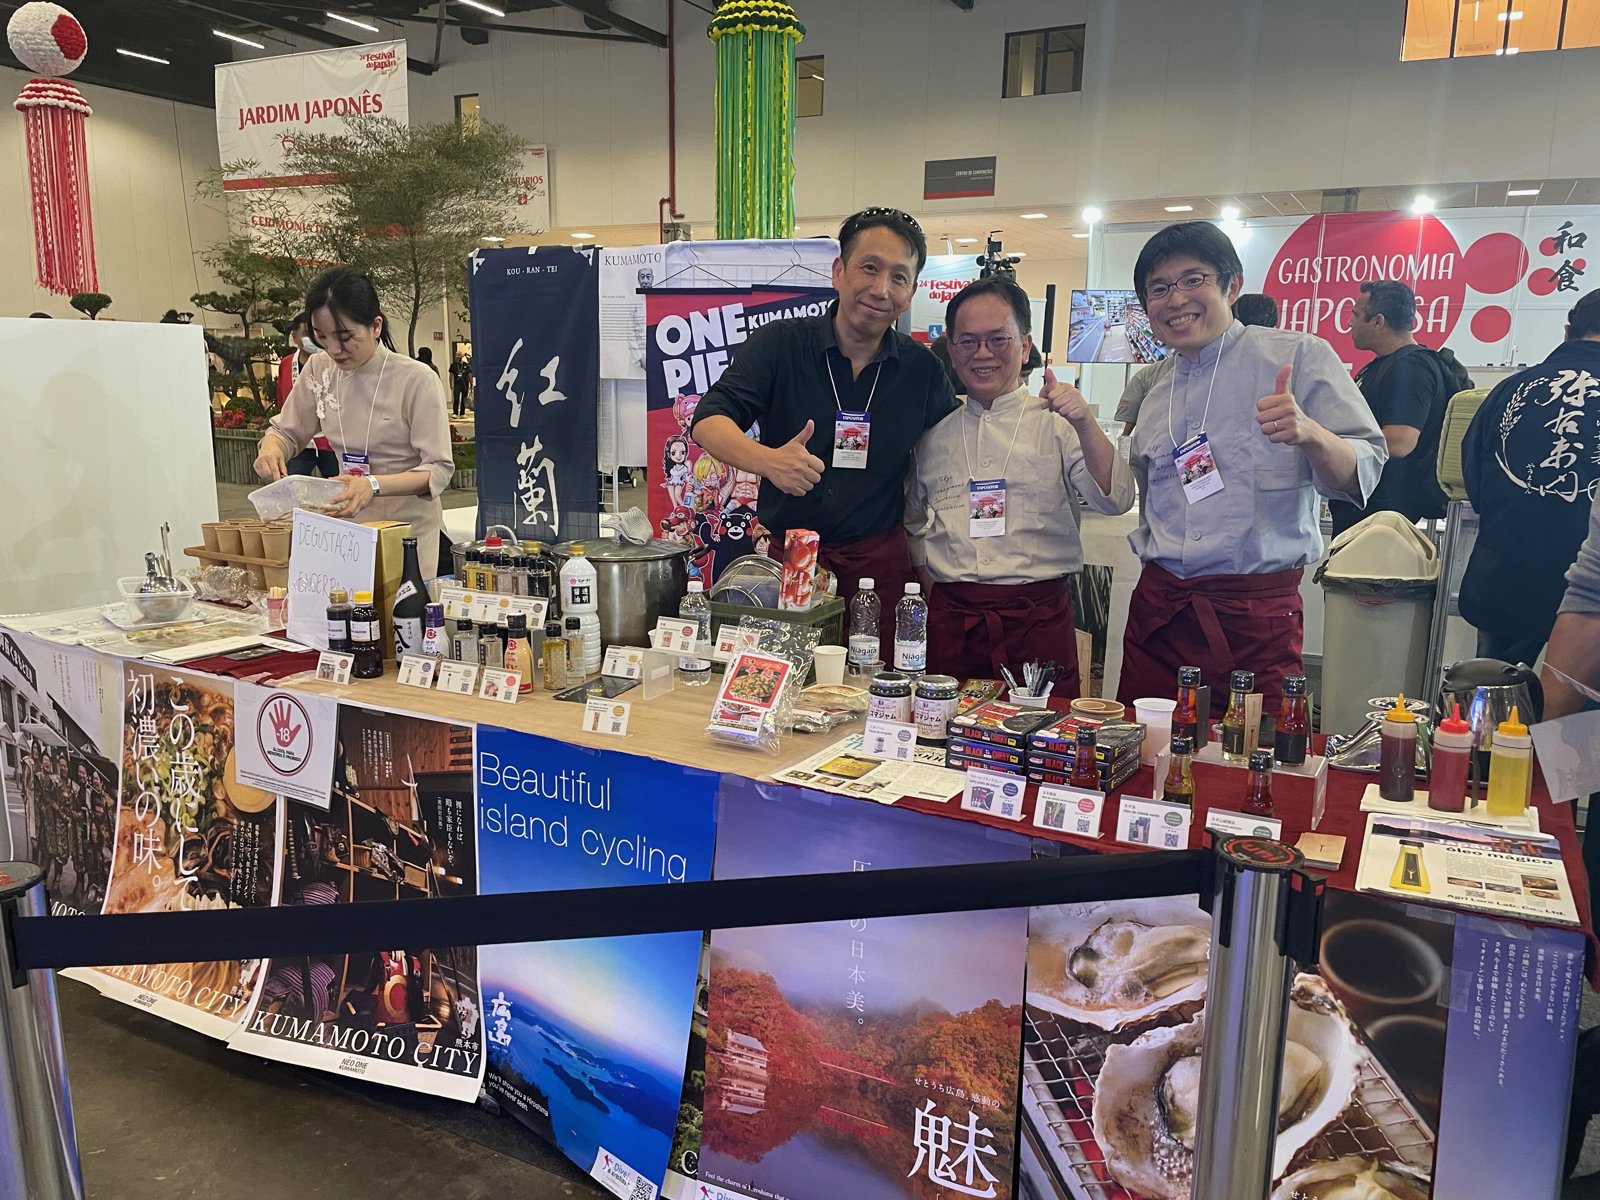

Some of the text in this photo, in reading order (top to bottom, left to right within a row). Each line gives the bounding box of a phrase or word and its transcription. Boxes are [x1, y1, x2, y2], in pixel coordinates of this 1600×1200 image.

[366, 50, 395, 61] Festival
[239, 89, 383, 130] JARDIM JAPONÊS
[527, 266, 540, 274] RAN
[547, 265, 558, 273] TEI
[605, 252, 662, 266] KUMAMOTO
[1278, 252, 1455, 285] GASTRONOMIA
[1548, 220, 1588, 292] 和食
[929, 291, 940, 299] do
[655, 302, 748, 356] ONE
[298, 522, 360, 562] DEGUSTAÇÃO
[276, 726, 290, 743] -18
[963, 728, 982, 738] BLACK
[1048, 741, 1067, 752] BLACK
[965, 746, 983, 756] BLACK
[1045, 758, 1064, 770] BLACK
[127, 669, 163, 888] 初濃いの味。
[169, 676, 199, 910] この歳にして
[480, 751, 611, 811] Beautiful
[480, 798, 568, 848] island
[581, 834, 687, 884] cycling
[194, 986, 248, 1019] CITY
[488, 991, 513, 1047] 広島
[250, 1010, 480, 1075] KUMAMOTO CITY
[454, 1037, 480, 1051] 熊本市
[488, 1080, 504, 1094] you've
[504, 1090, 517, 1102] never
[488, 1072, 502, 1083] We'll
[502, 1080, 514, 1091] show
[514, 1088, 523, 1098] you
[527, 1096, 549, 1117] Hiroshima
[906, 1098, 1000, 1199] 魅
[705, 1171, 715, 1179] Feel
[725, 1178, 740, 1187] charm
